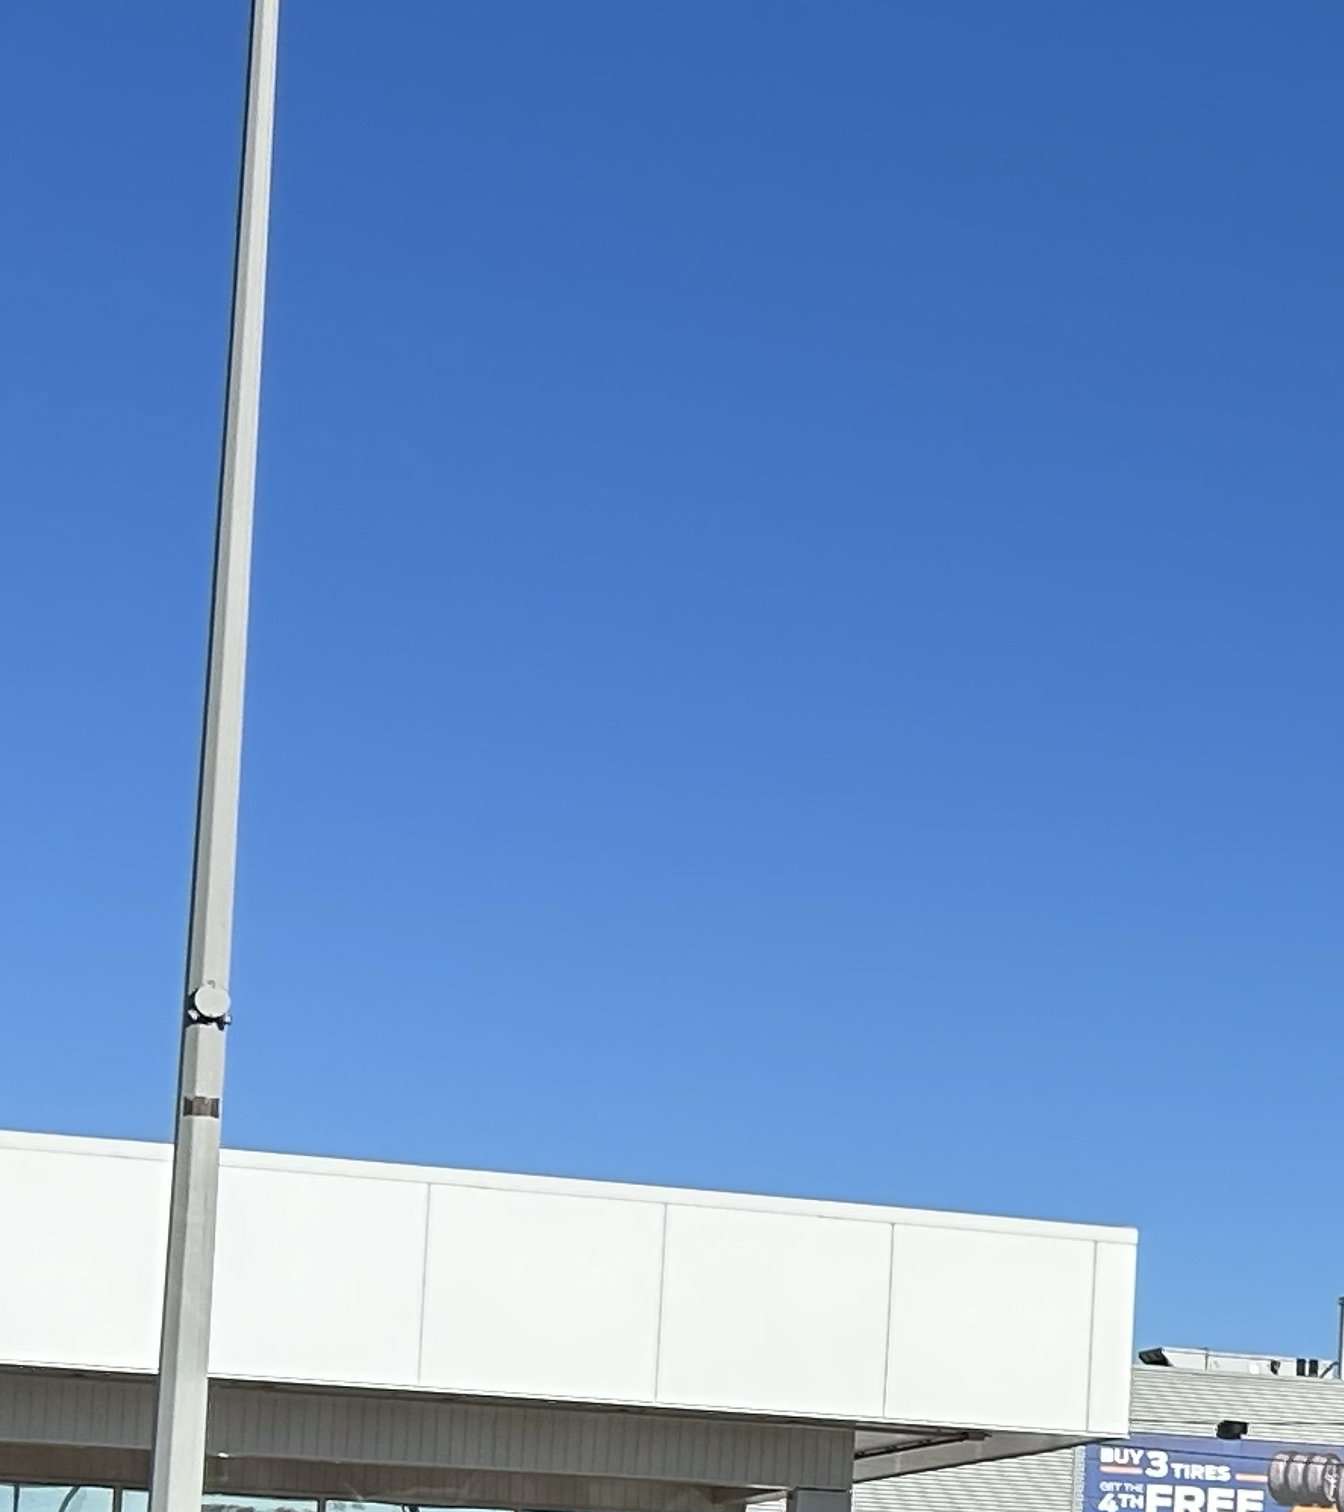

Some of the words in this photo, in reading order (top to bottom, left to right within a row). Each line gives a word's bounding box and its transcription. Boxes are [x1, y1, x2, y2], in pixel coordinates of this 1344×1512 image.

[1100, 1447, 1144, 1465] BUY
[1145, 1450, 1169, 1478] 3
[1171, 1462, 1232, 1482] TIRES
[1099, 1481, 1123, 1492] GET
[1123, 1482, 1144, 1494] THE
